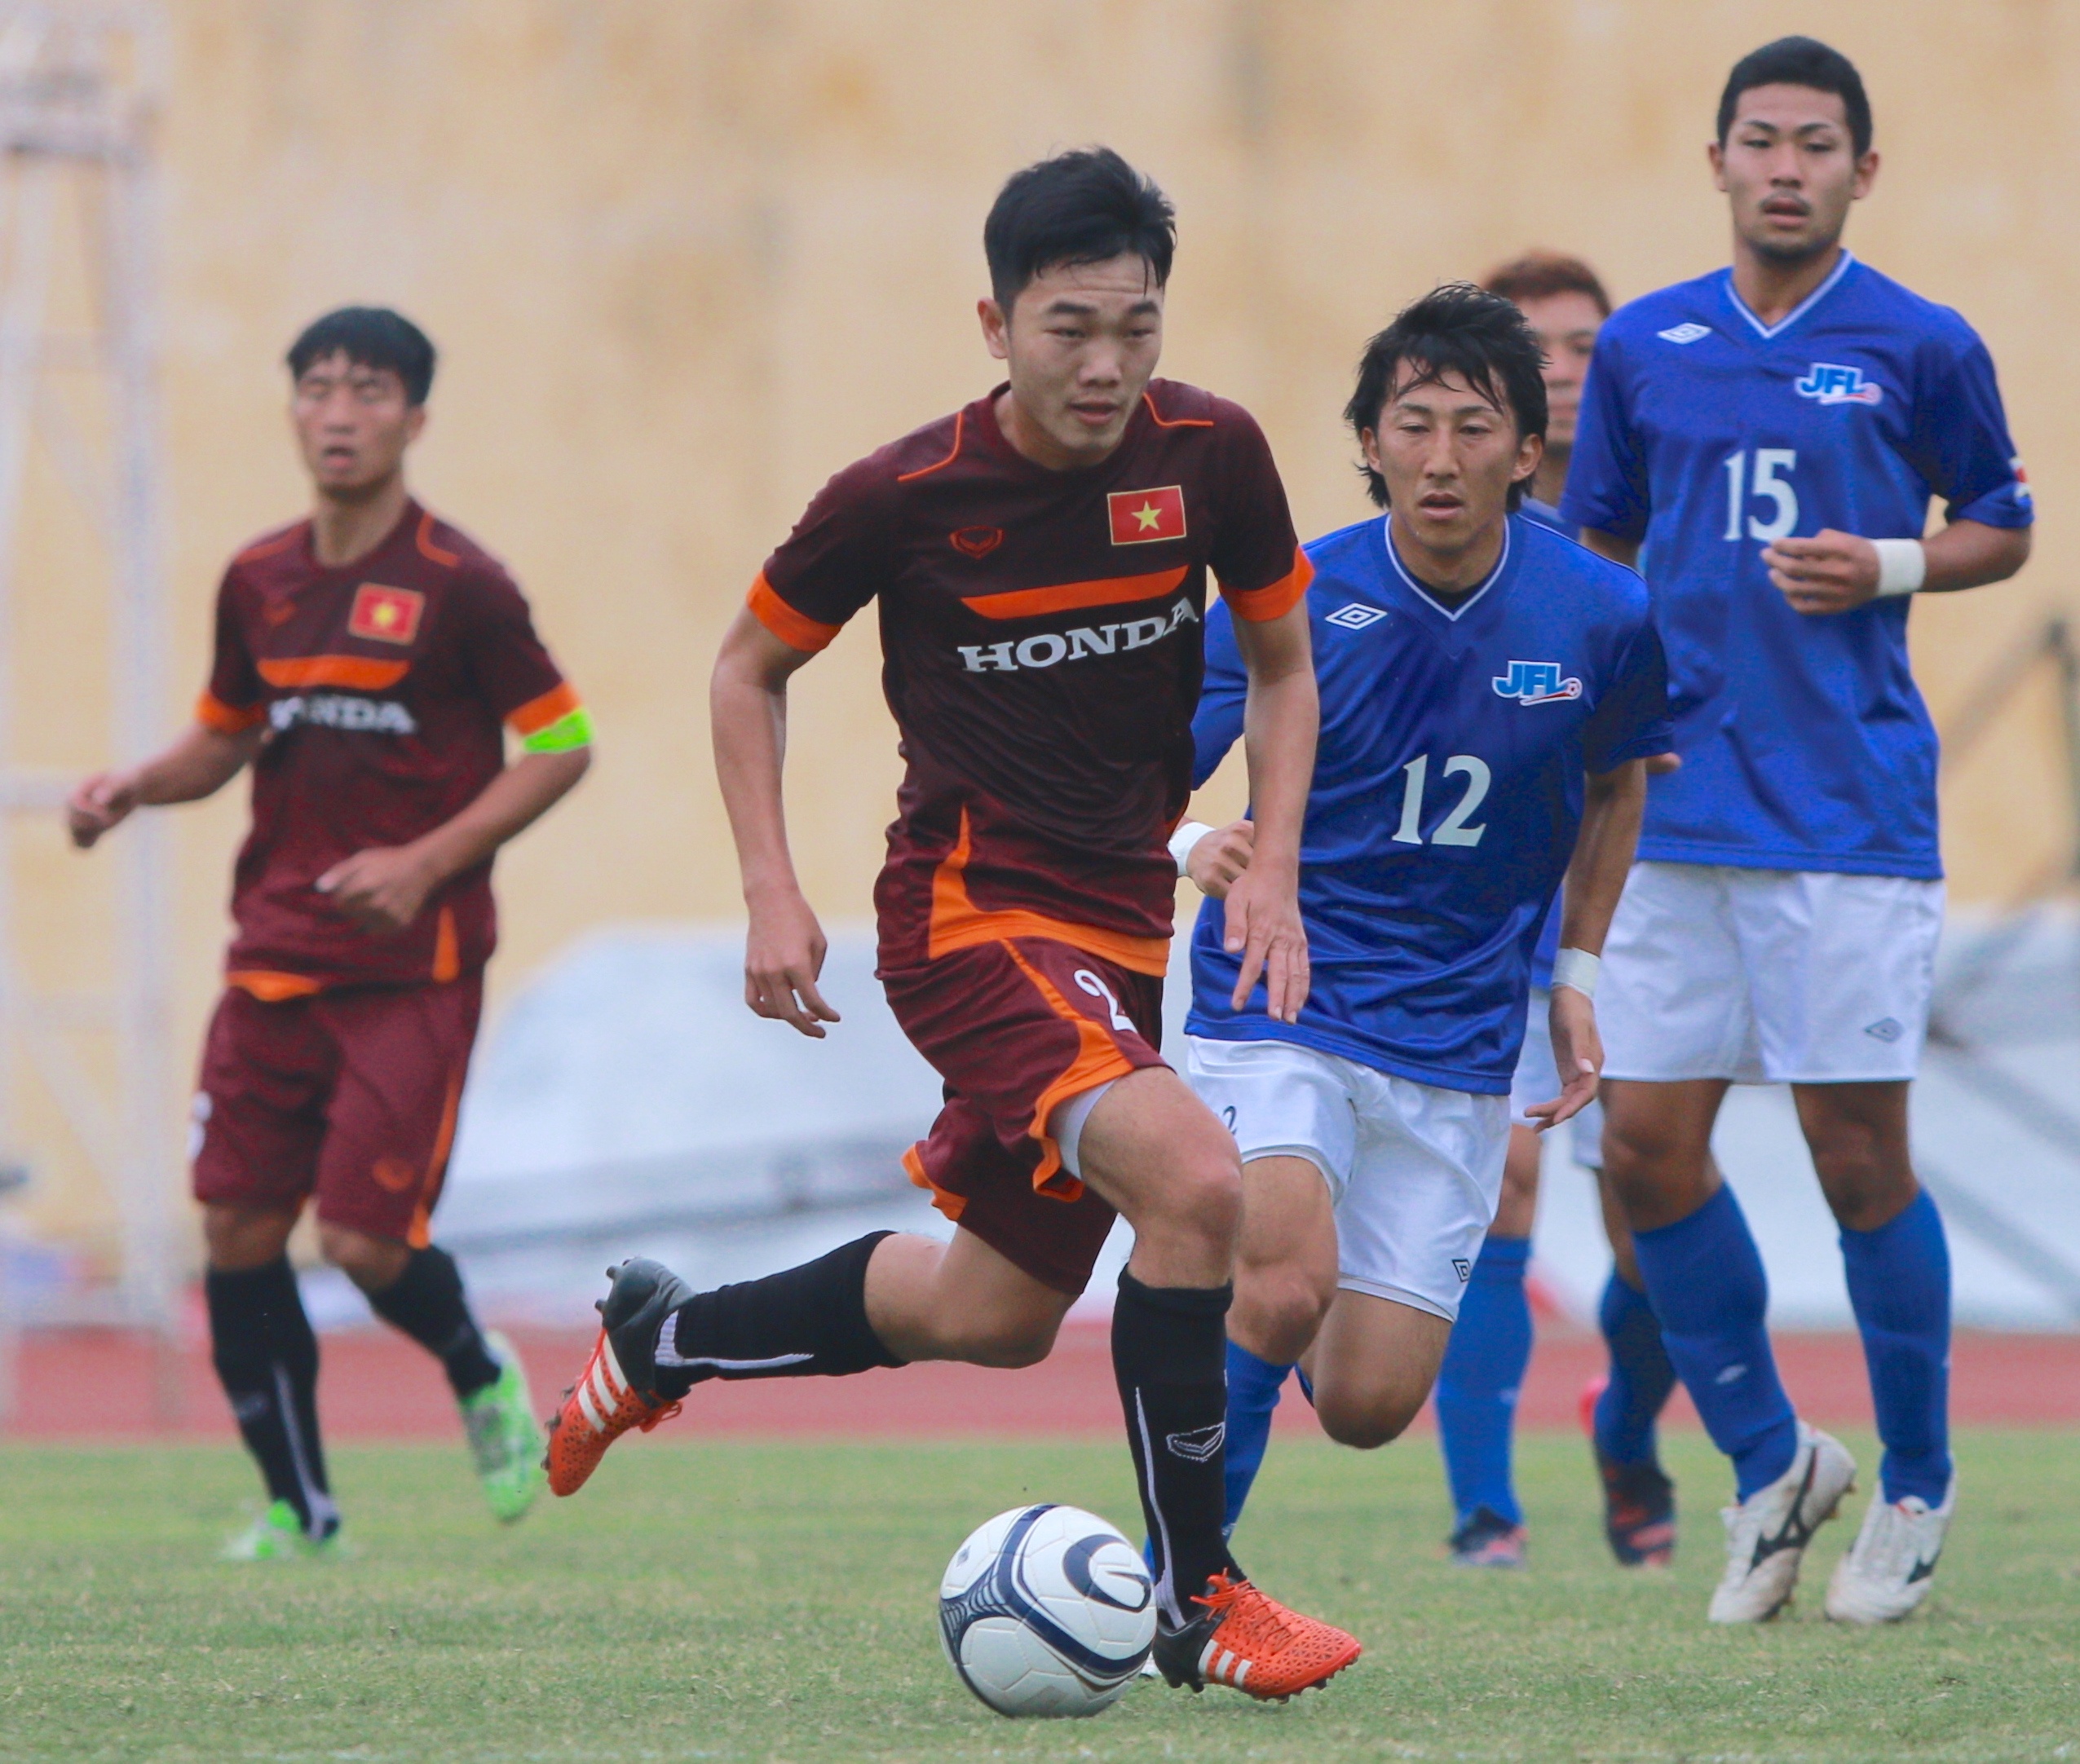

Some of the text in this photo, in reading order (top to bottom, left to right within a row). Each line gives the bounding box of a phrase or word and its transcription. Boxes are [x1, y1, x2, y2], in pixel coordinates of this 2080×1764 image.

[1797, 364, 1869, 398] JFL
[1723, 448, 1799, 542] 15
[957, 597, 1199, 673] HONDA
[1492, 660, 1571, 699] JFL
[269, 695, 417, 734] NDA
[1392, 754, 1491, 847] 12
